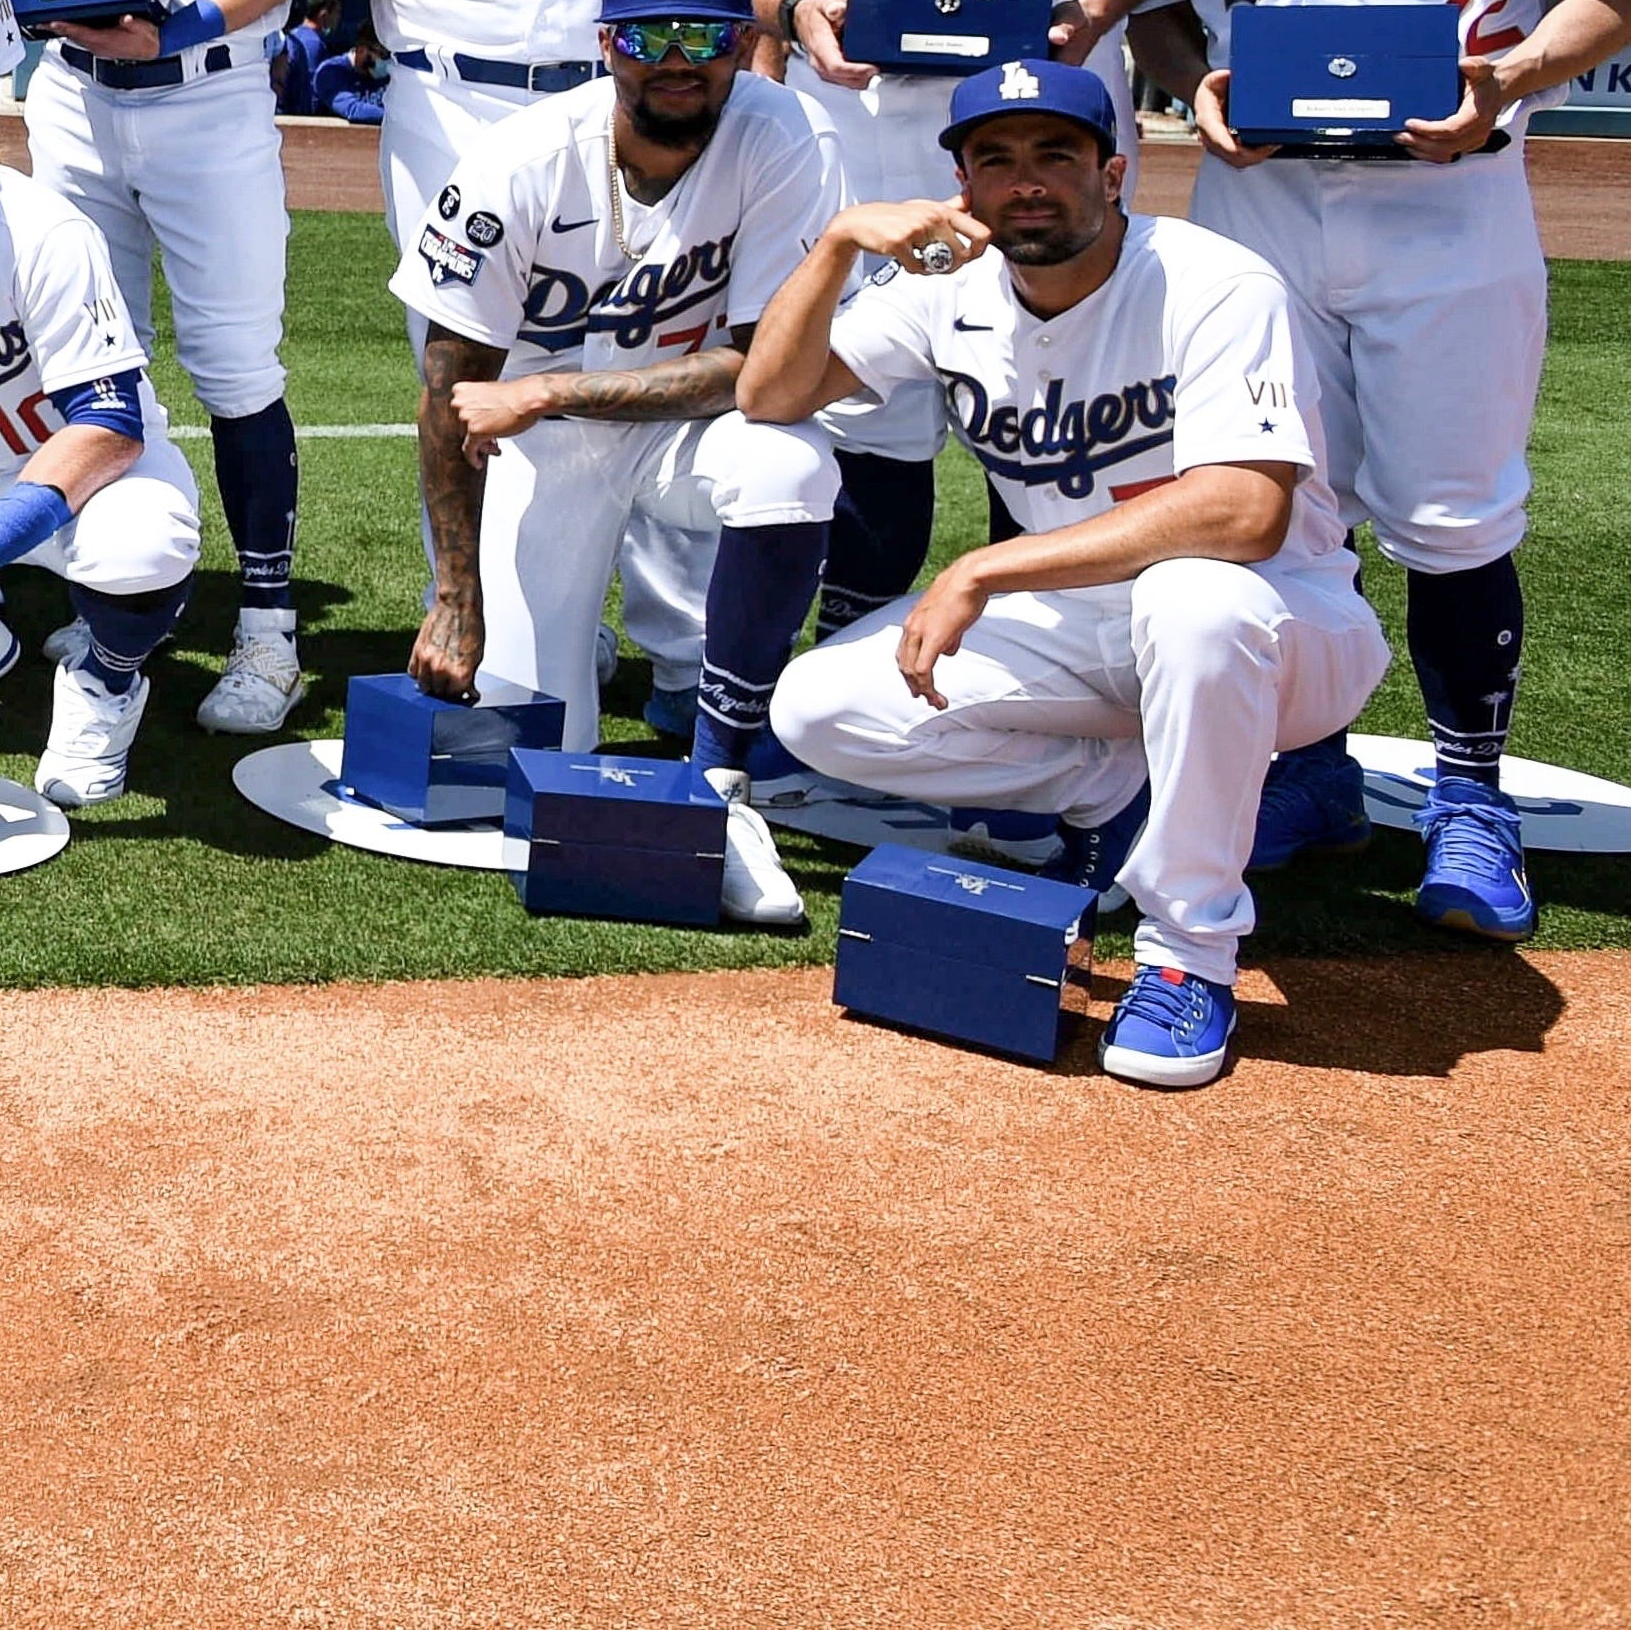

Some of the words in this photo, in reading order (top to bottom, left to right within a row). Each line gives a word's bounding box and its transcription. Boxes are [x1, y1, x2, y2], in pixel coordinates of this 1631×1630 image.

[1000, 62, 1039, 99] LA
[85, 297, 116, 323] VII
[1245, 377, 1288, 408] VII
[940, 370, 1176, 499] Dodgers
